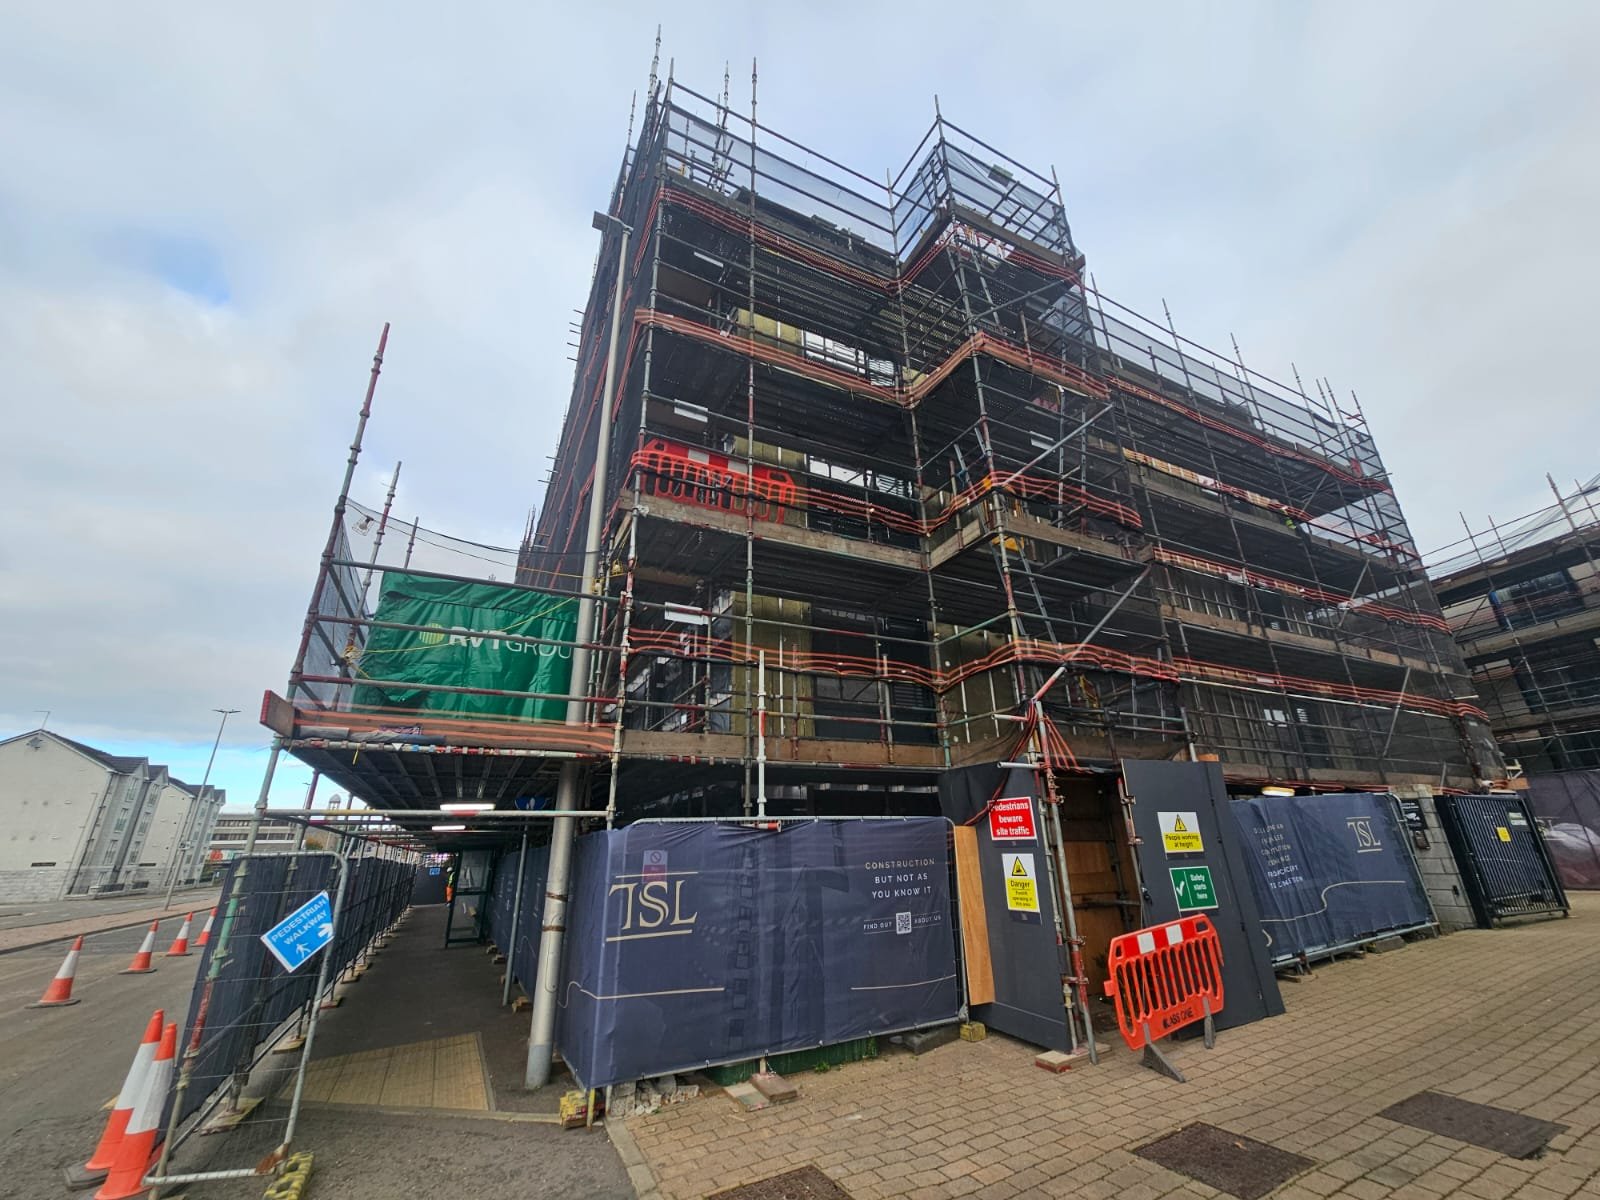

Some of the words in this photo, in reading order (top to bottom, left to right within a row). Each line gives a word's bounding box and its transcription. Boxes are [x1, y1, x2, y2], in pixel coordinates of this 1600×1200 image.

[998, 815, 1022, 823] beware
[996, 827, 1008, 836] site
[1009, 826, 1031, 836] traffic
[1346, 820, 1381, 848] TSL
[865, 858, 935, 869] CONSTRUCTION
[874, 875, 893, 884] BUT
[896, 874, 914, 883] NOT
[917, 872, 928, 881] AS
[1010, 880, 1030, 889] Danger
[872, 890, 890, 899] YOU
[894, 887, 920, 897] KNOW
[923, 886, 931, 894] IT
[609, 880, 698, 930] TSL
[271, 898, 327, 943] PEDESTRIAN
[283, 909, 327, 945] WALKWAY
[880, 921, 892, 929] OUT
[914, 916, 932, 924] ABOUT
